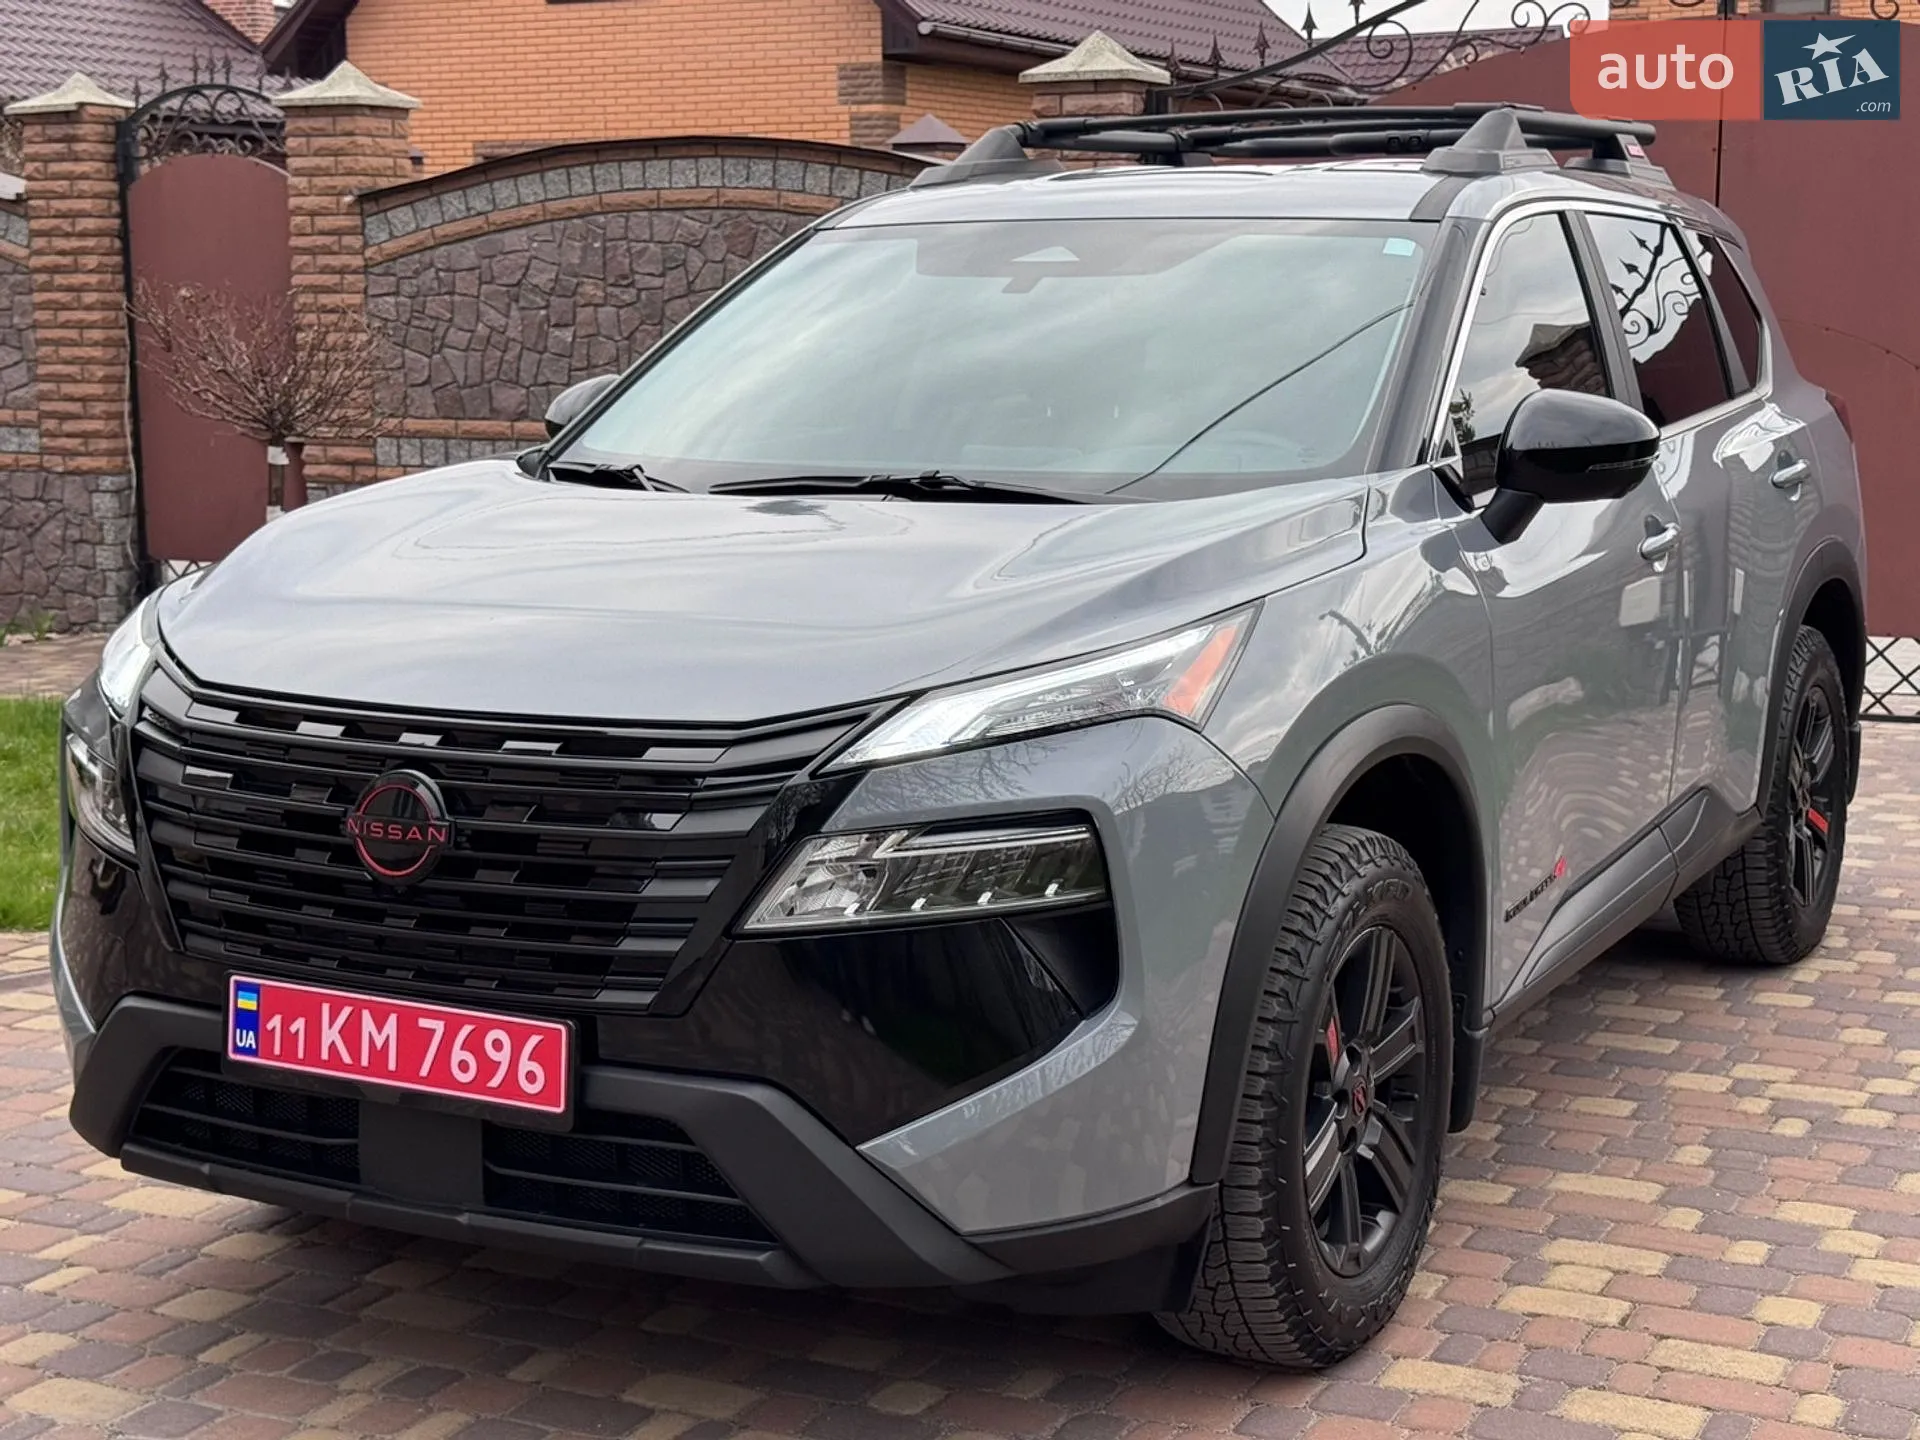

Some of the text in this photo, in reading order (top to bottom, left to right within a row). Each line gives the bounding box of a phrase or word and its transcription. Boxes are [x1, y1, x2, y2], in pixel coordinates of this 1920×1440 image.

[346, 817, 447, 843] NISSAN
[235, 1028, 257, 1050] UA
[265, 1002, 547, 1095] 11 KM 7696
